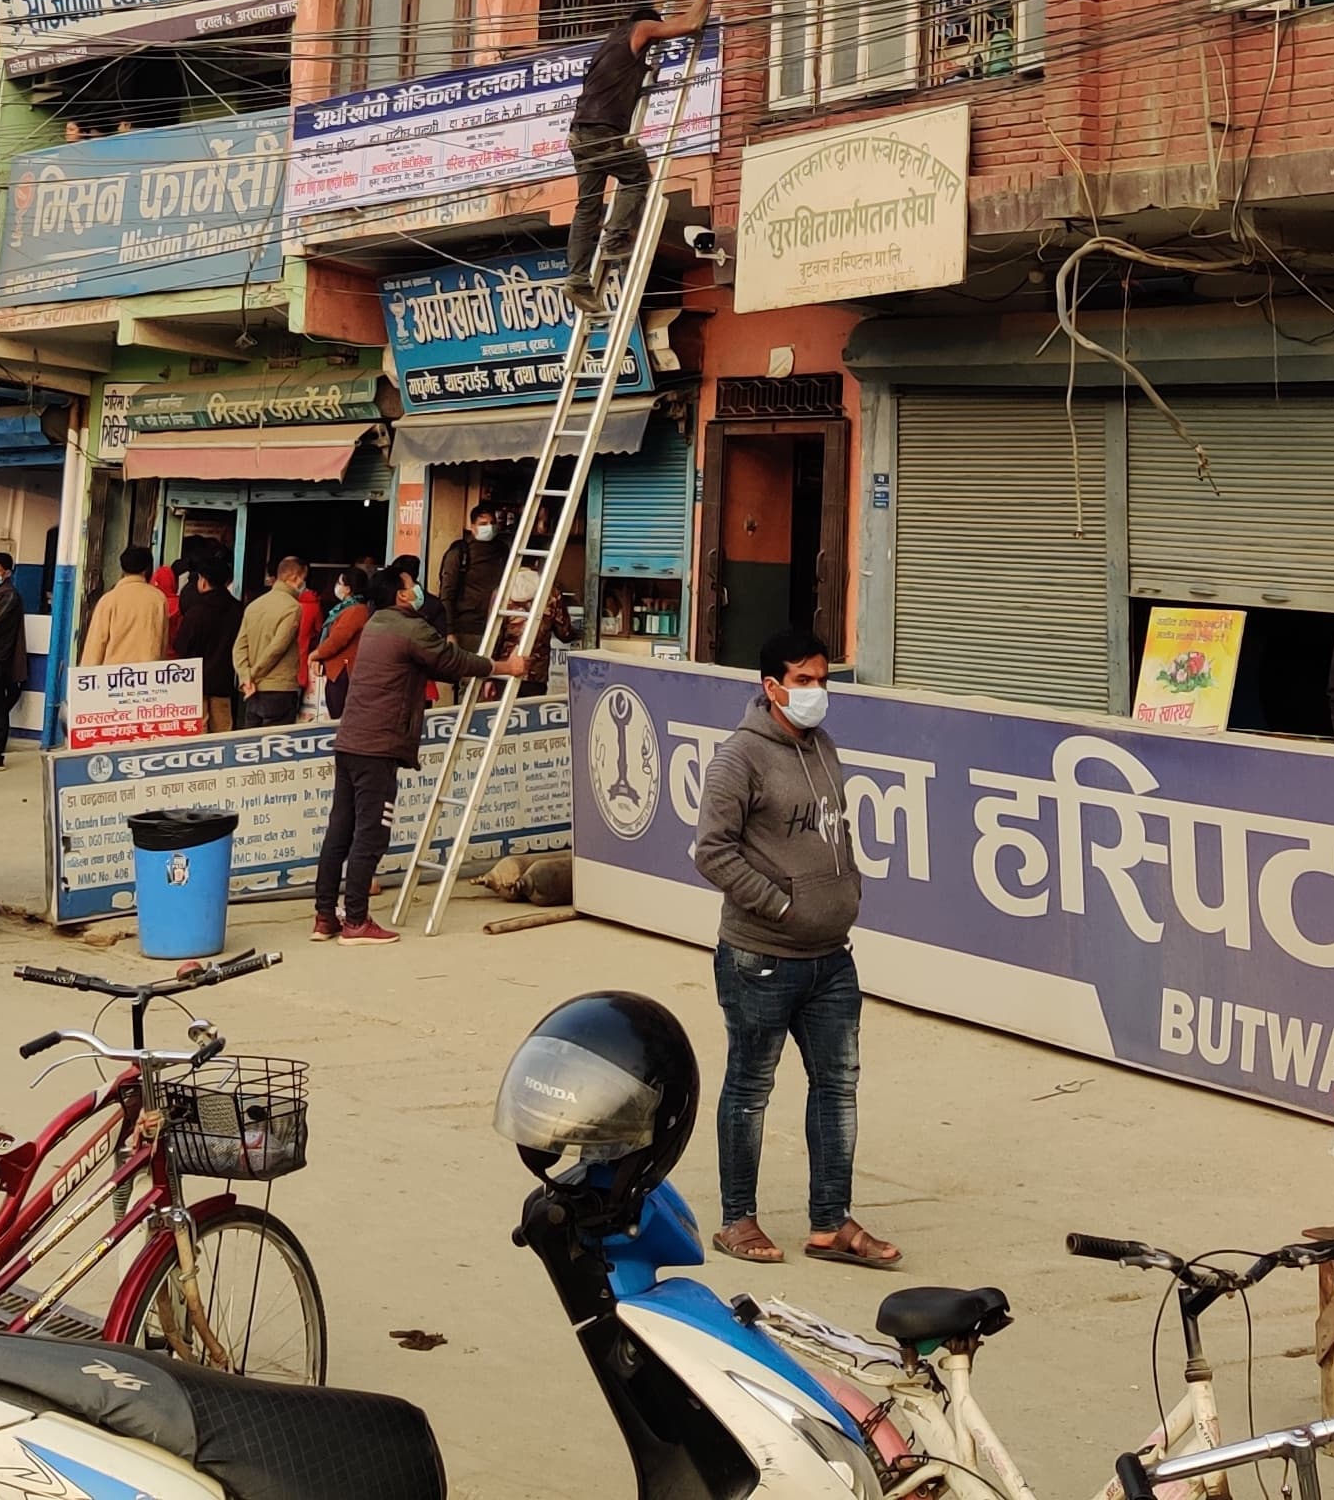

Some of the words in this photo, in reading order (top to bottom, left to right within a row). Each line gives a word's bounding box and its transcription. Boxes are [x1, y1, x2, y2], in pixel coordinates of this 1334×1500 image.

[32, 164, 132, 238] मिसन
[742, 183, 780, 237] नेपाल
[901, 187, 937, 229] सेवा
[119, 225, 181, 264] Mission
[514, 364, 536, 386] तथा
[77, 674, 100, 692] डा.
[107, 666, 149, 692] प्रदिप
[117, 746, 225, 779] बुटवल
[161, 781, 184, 799] कृष्ण
[241, 771, 266, 787] ज्योति
[239, 794, 261, 812] Jyoti
[253, 814, 271, 826] BDS
[77, 872, 96, 885] NMC
[113, 868, 129, 881] 406
[273, 847, 296, 860] 2495
[523, 1074, 578, 1104] HONDA
[51, 1131, 111, 1206] GANG
